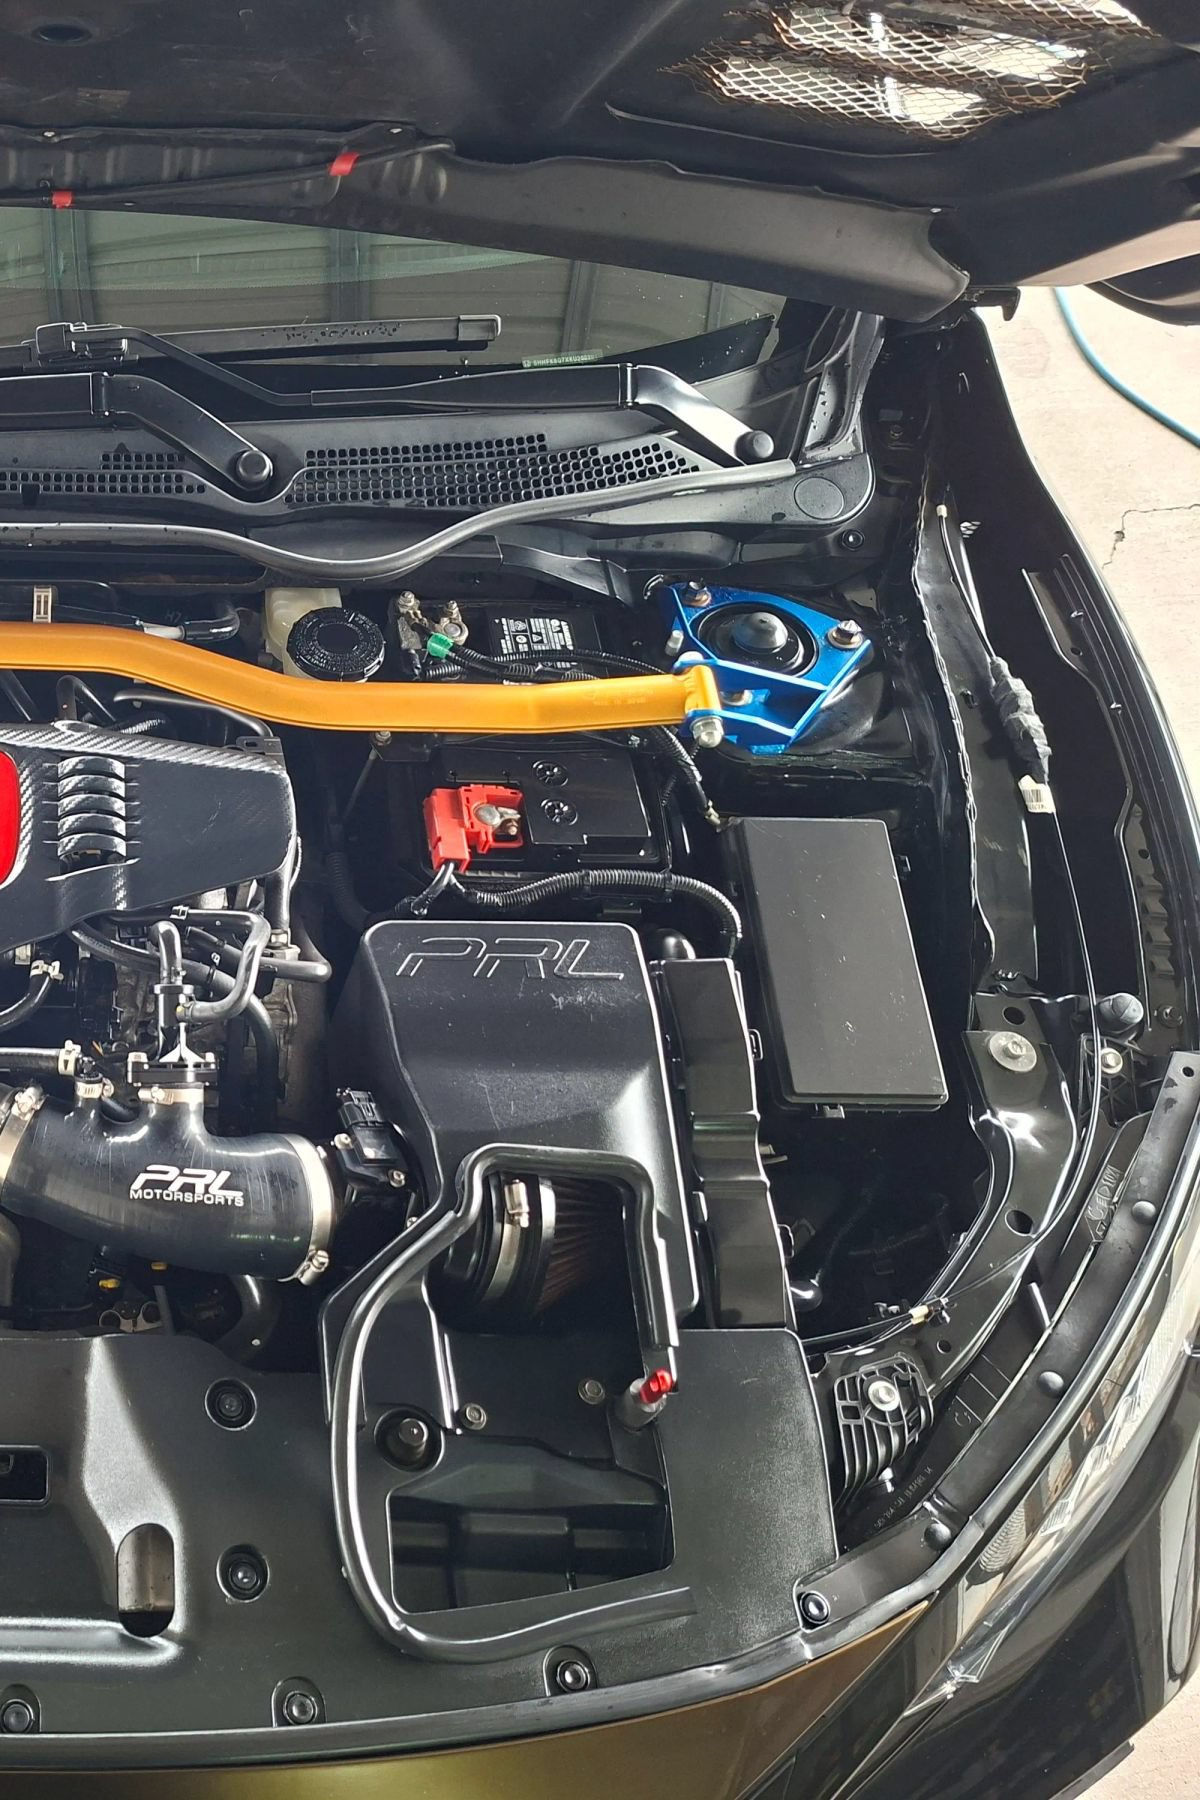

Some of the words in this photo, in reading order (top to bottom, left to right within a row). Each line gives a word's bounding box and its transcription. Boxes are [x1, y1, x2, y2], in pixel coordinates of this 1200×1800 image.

[396, 937, 624, 980] PRL
[130, 1164, 243, 1196] PRL
[130, 1189, 244, 1207] MOTORSPORTS
